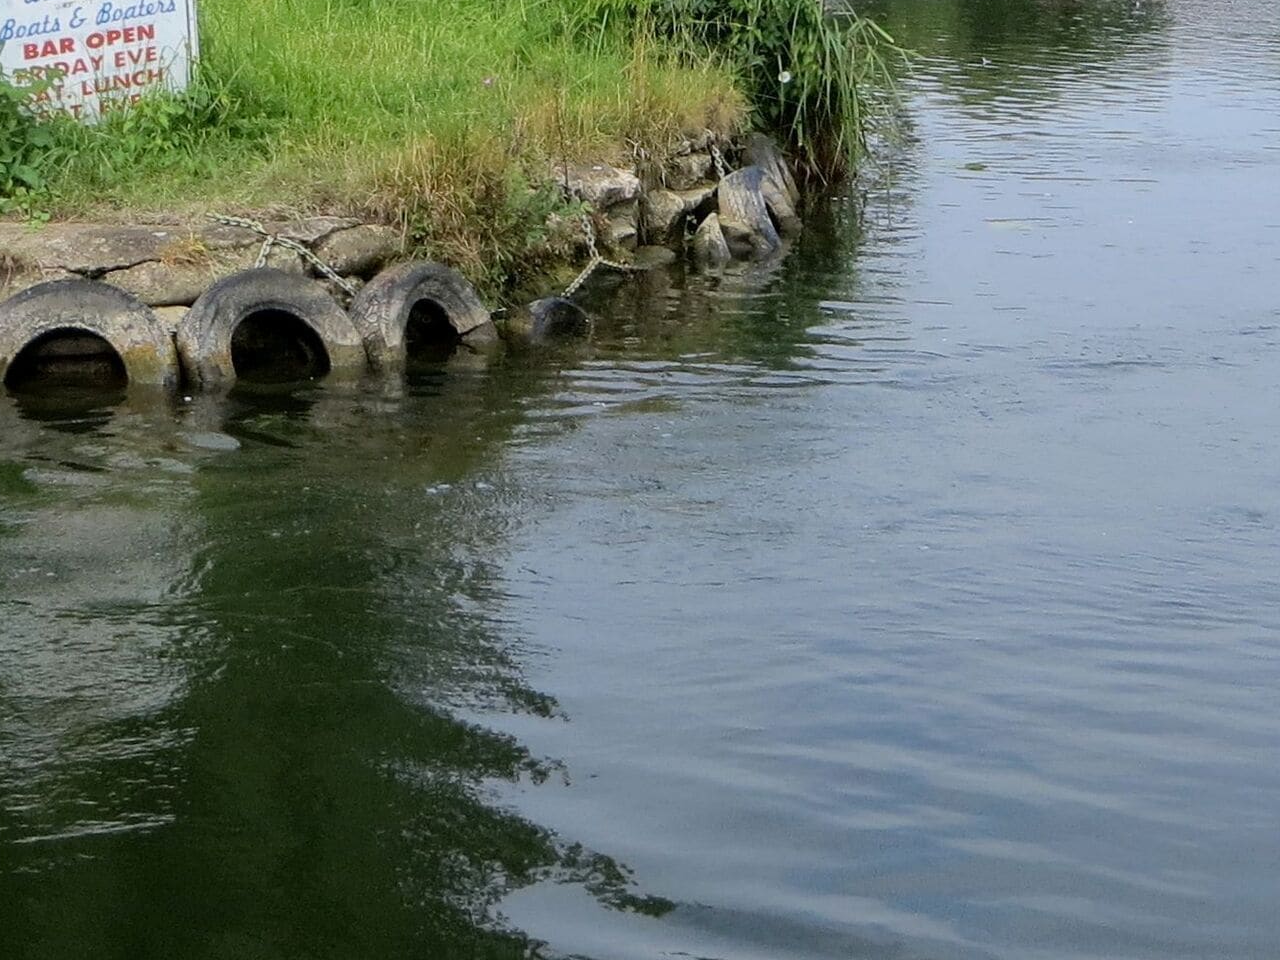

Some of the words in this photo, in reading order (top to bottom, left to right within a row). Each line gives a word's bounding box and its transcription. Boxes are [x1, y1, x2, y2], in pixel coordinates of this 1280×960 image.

[0, 18, 60, 41] Boats
[70, 7, 87, 28] &
[23, 37, 75, 60] BAR
[86, 24, 155, 49] OPEN
[13, 55, 103, 84] FRDAY
[114, 46, 157, 67] EVE
[81, 68, 163, 95] LUNCH
